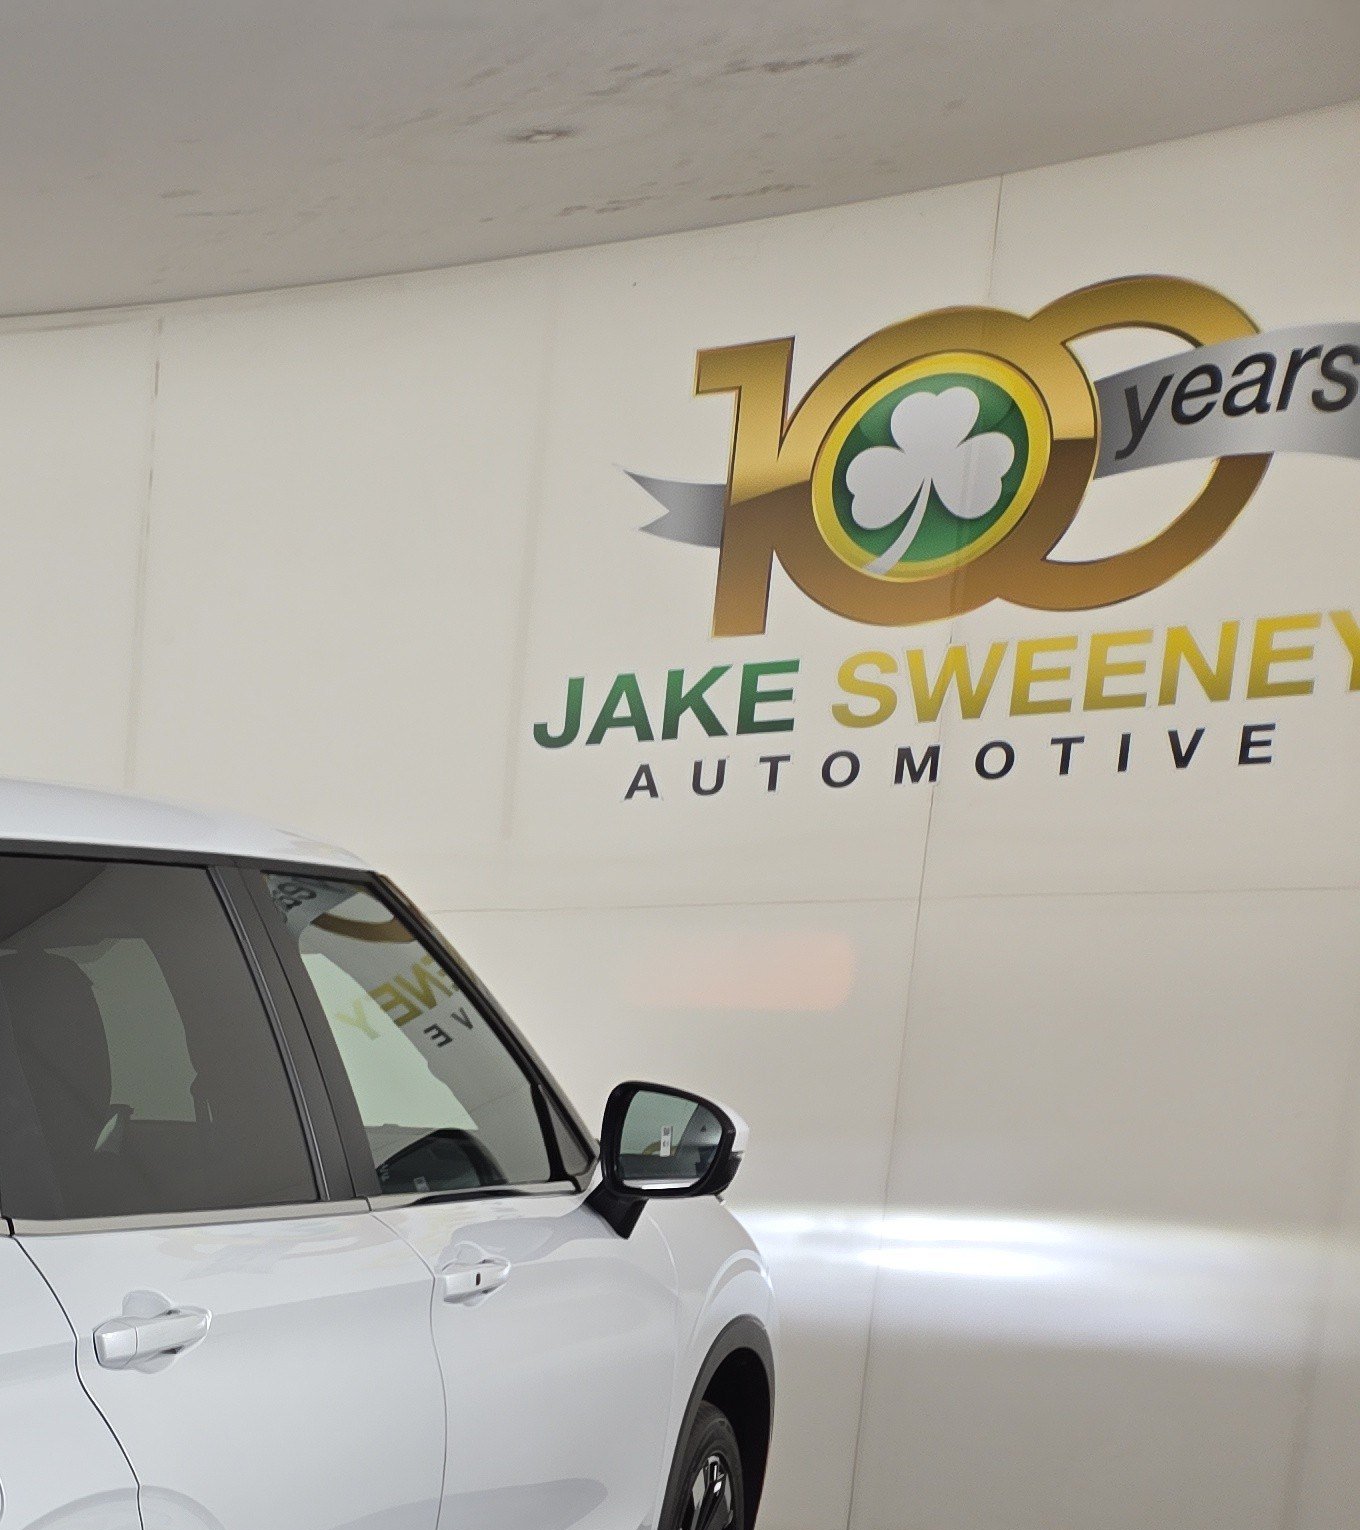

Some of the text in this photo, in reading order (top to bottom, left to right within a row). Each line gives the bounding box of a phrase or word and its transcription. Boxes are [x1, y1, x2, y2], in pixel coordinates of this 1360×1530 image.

[1115, 344, 1360, 461] years
[533, 659, 801, 749] JAKE
[624, 722, 1277, 800] AUTOMOTIVE
